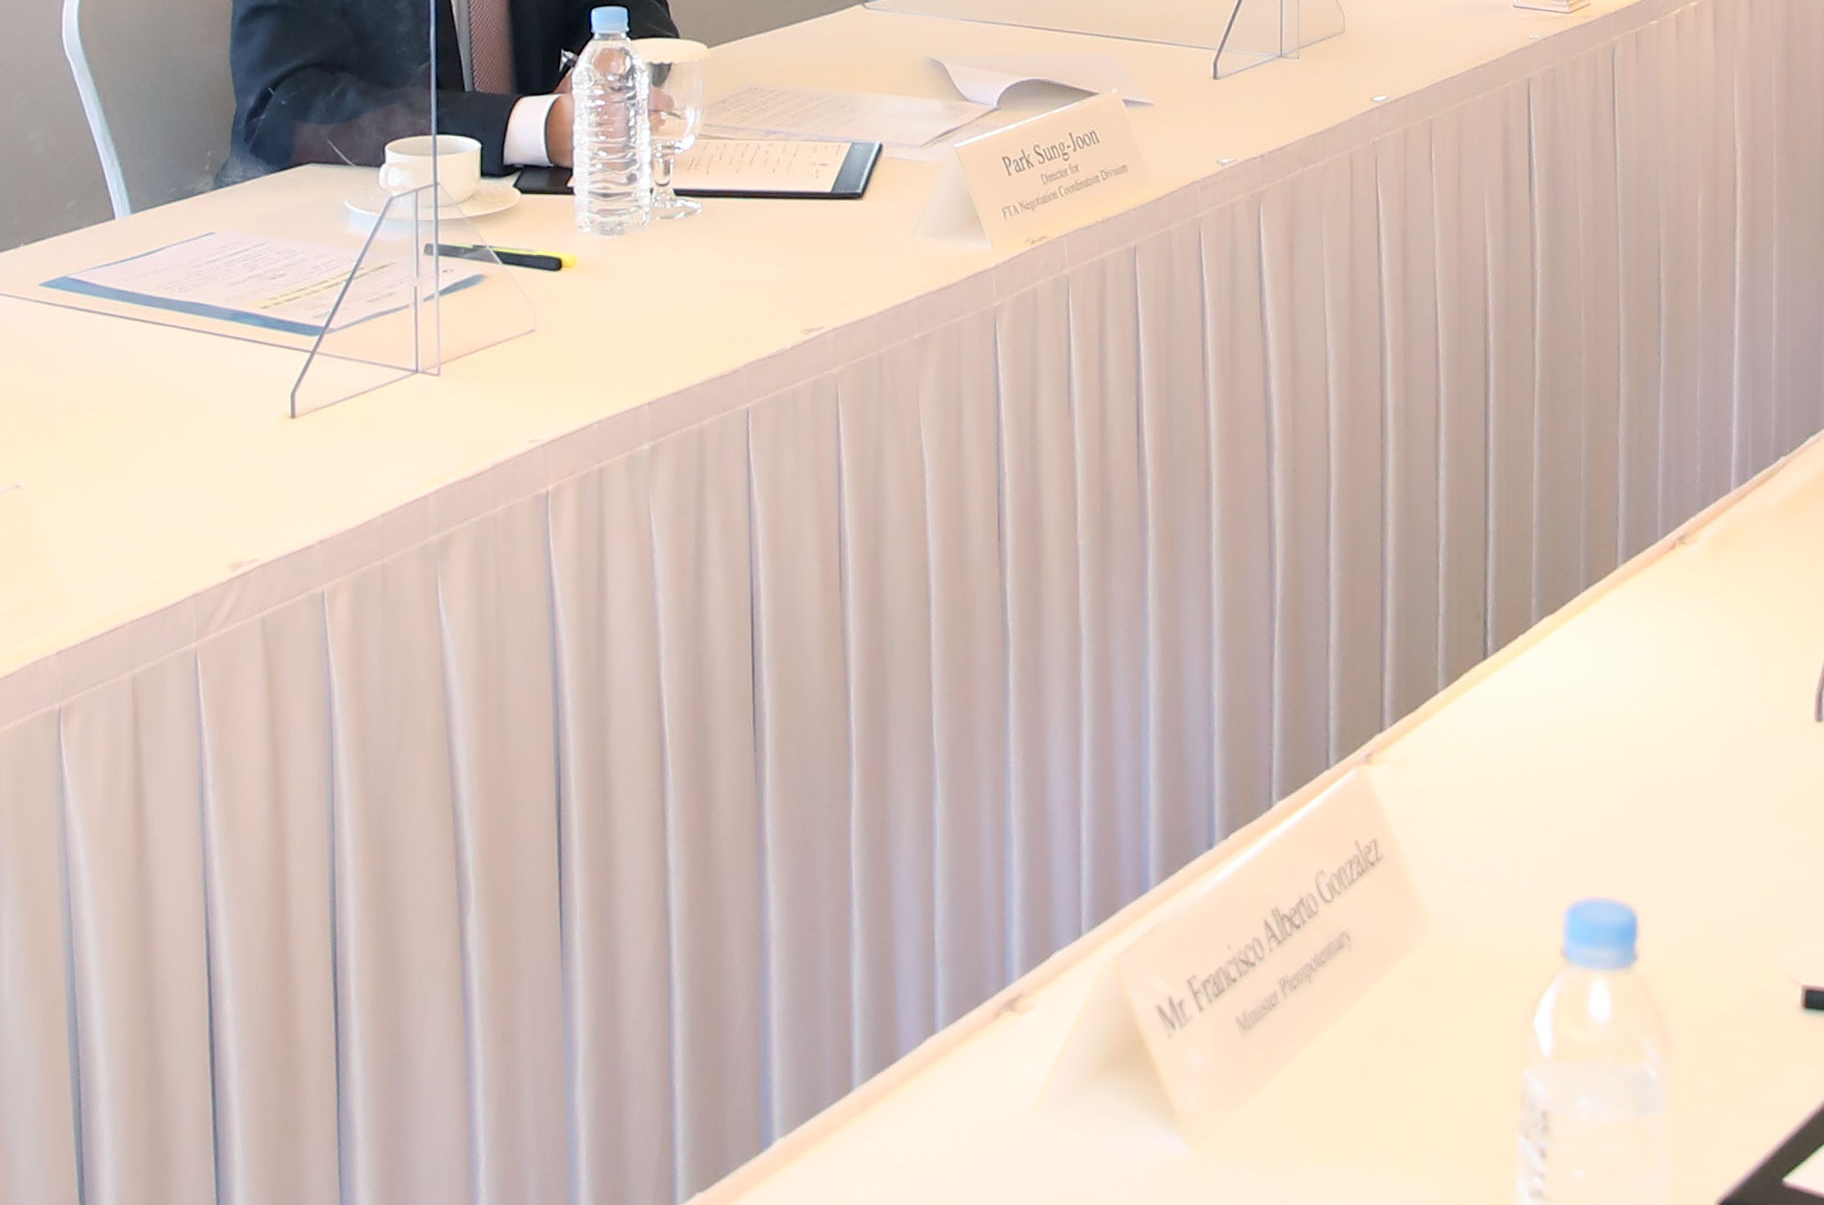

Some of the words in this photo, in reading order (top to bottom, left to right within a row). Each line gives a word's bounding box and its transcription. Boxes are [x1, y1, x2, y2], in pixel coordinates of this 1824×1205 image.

[1001, 148, 1035, 176] Park
[1033, 130, 1101, 165] Sung-Joon
[1001, 203, 1020, 220] FTA
[1156, 994, 1193, 1038] Mr.
[1186, 936, 1266, 1014] Francisco
[1263, 891, 1319, 953] Alberto
